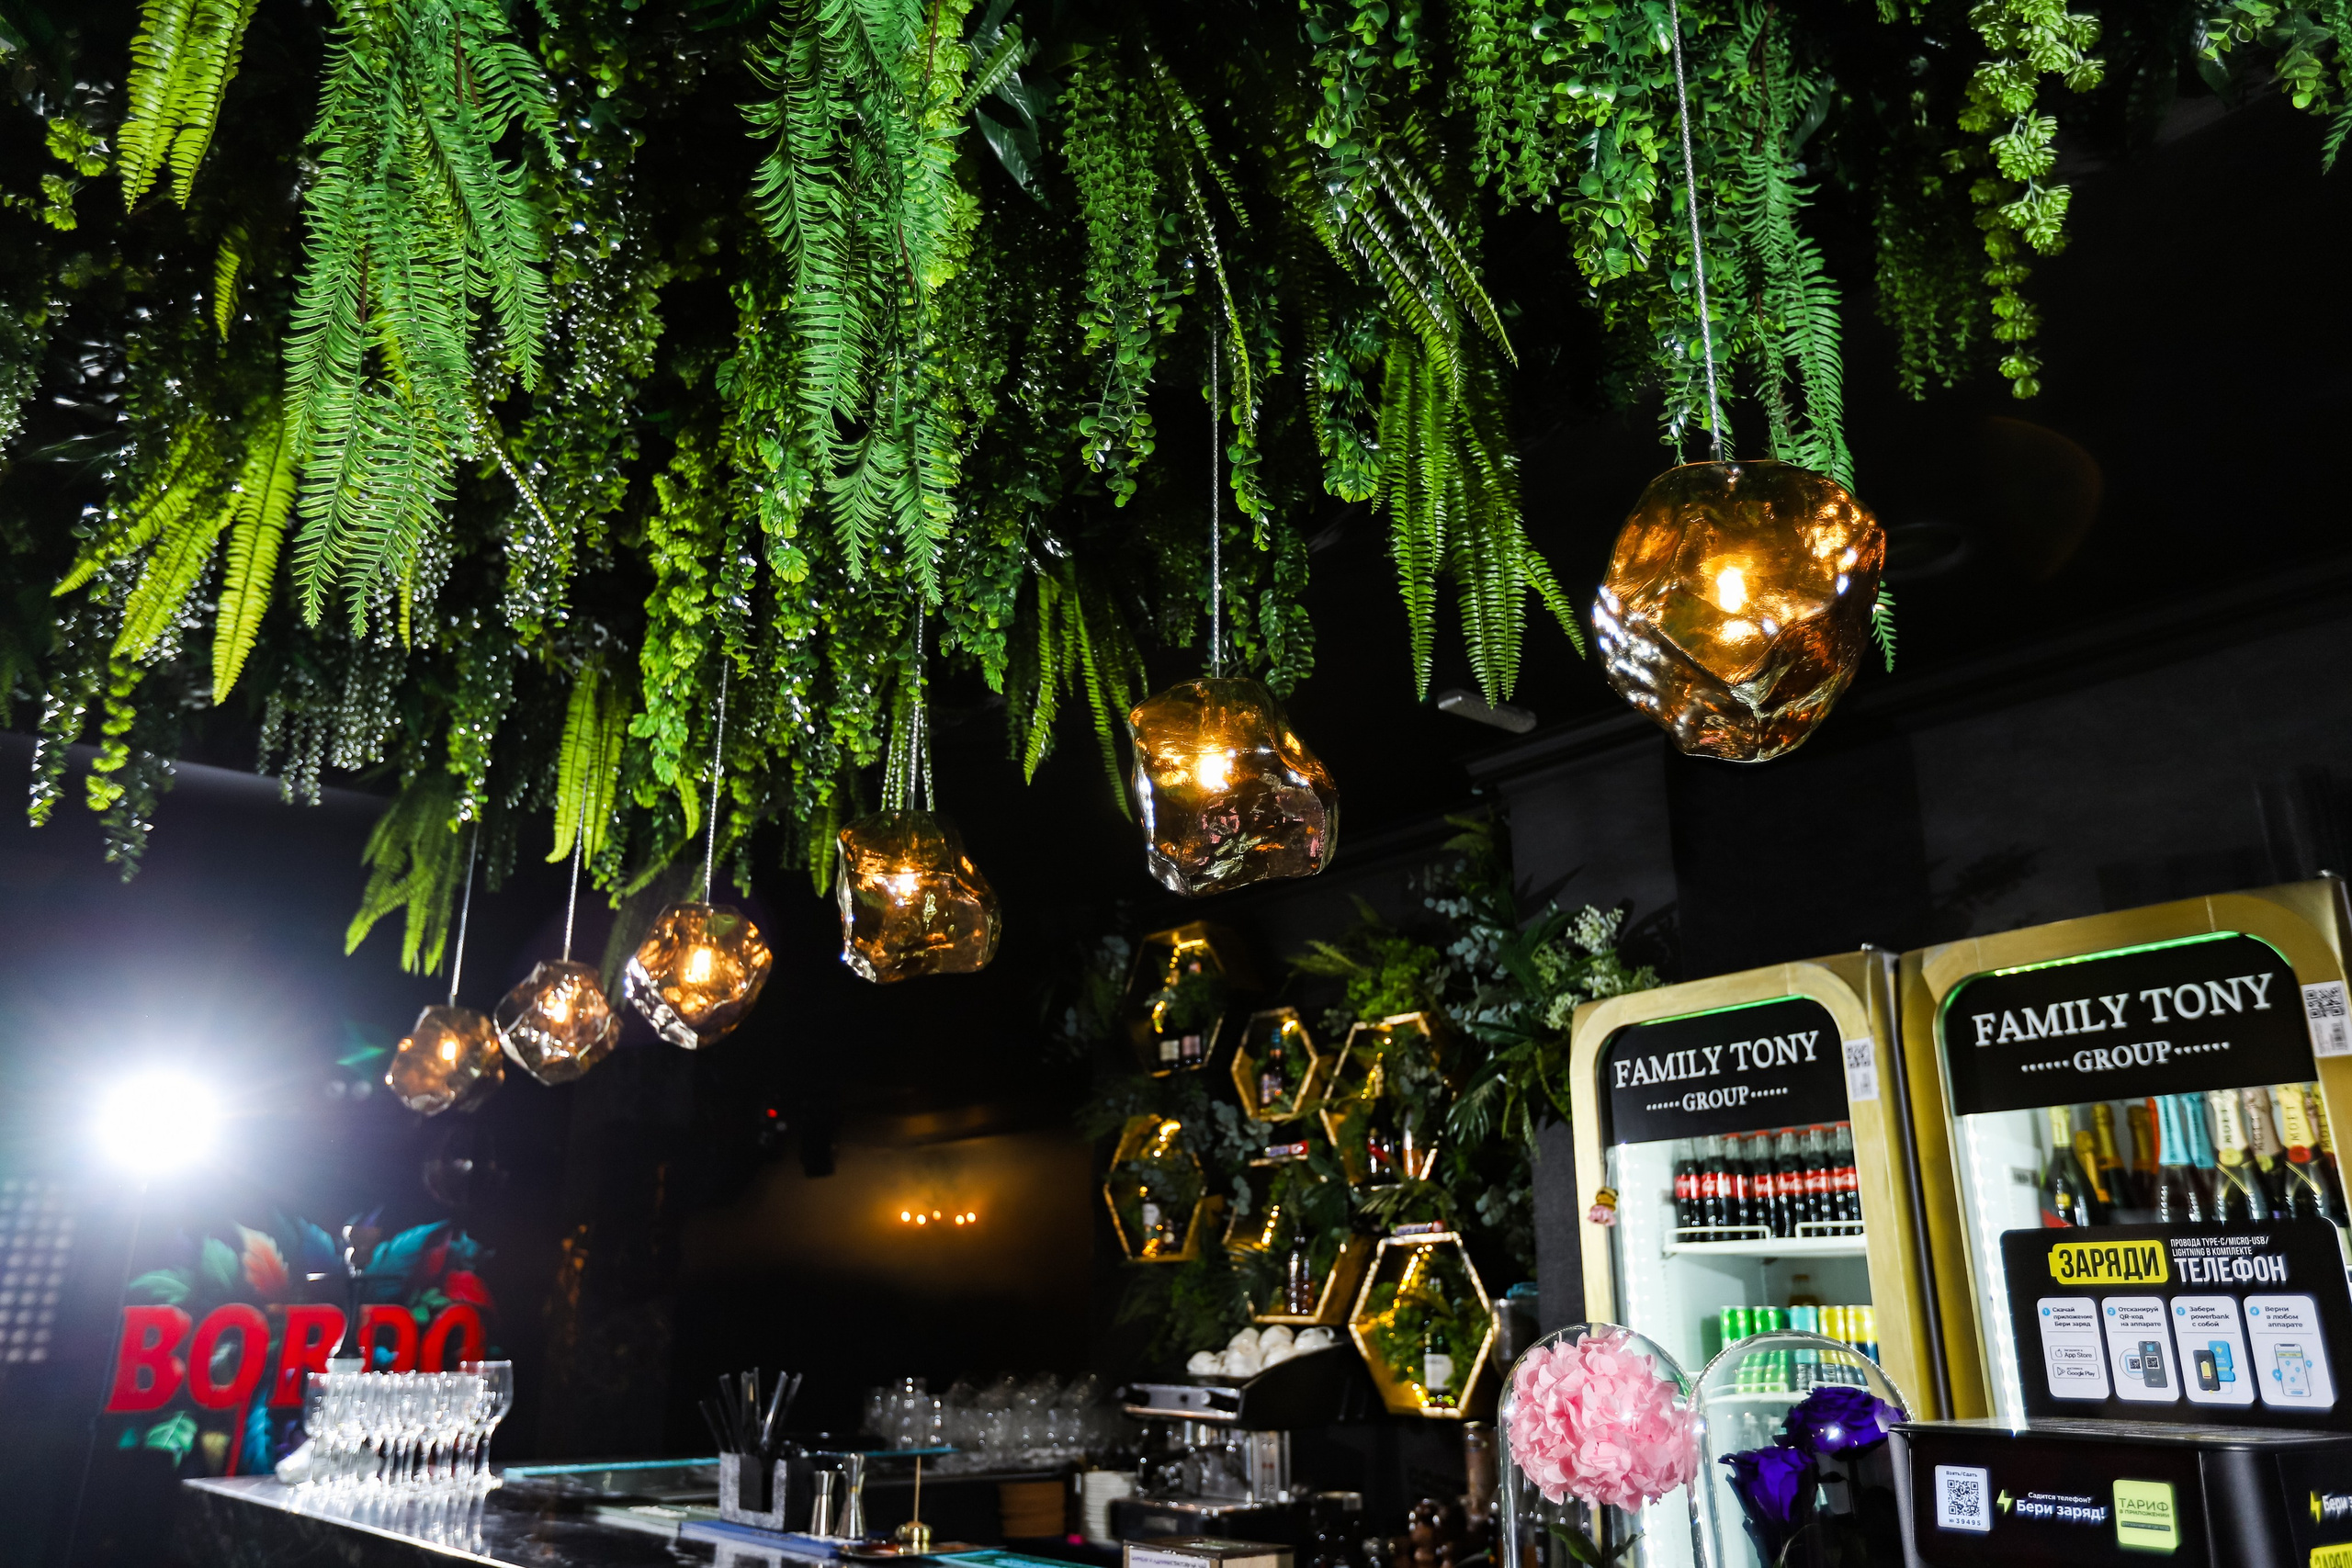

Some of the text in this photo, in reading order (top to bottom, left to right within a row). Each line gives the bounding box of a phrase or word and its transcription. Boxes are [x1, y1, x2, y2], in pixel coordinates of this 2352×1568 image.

[1972, 972, 2274, 1048] FAMILY TONY
[1613, 1030, 1820, 1089] FAMILY TONY
[2073, 1040, 2171, 1073] GROUP
[1681, 1085, 1750, 1112] GROUP
[2170, 1237, 2201, 1247] ПРОВОДА
[2171, 1247, 2253, 1258] LIGHTNING В КОМПЛЕКТЕ
[2058, 1246, 2161, 1280] ЗАРЯДИ
[2174, 1255, 2287, 1283] ТЕЛЕФОН
[104, 1302, 487, 1426] BORDO
[1945, 1470, 1978, 1478] Взять/Сдать
[2028, 1492, 2092, 1505] Садится телефон?
[2118, 1497, 2169, 1512] ТАРИФ
[2321, 1495, 2348, 1515] Бери
[2016, 1499, 2106, 1521] Бери заряд!
[2124, 1509, 2170, 1518] ПРИЛОЖЕНИИ
[1955, 1517, 1982, 1527] 39495
